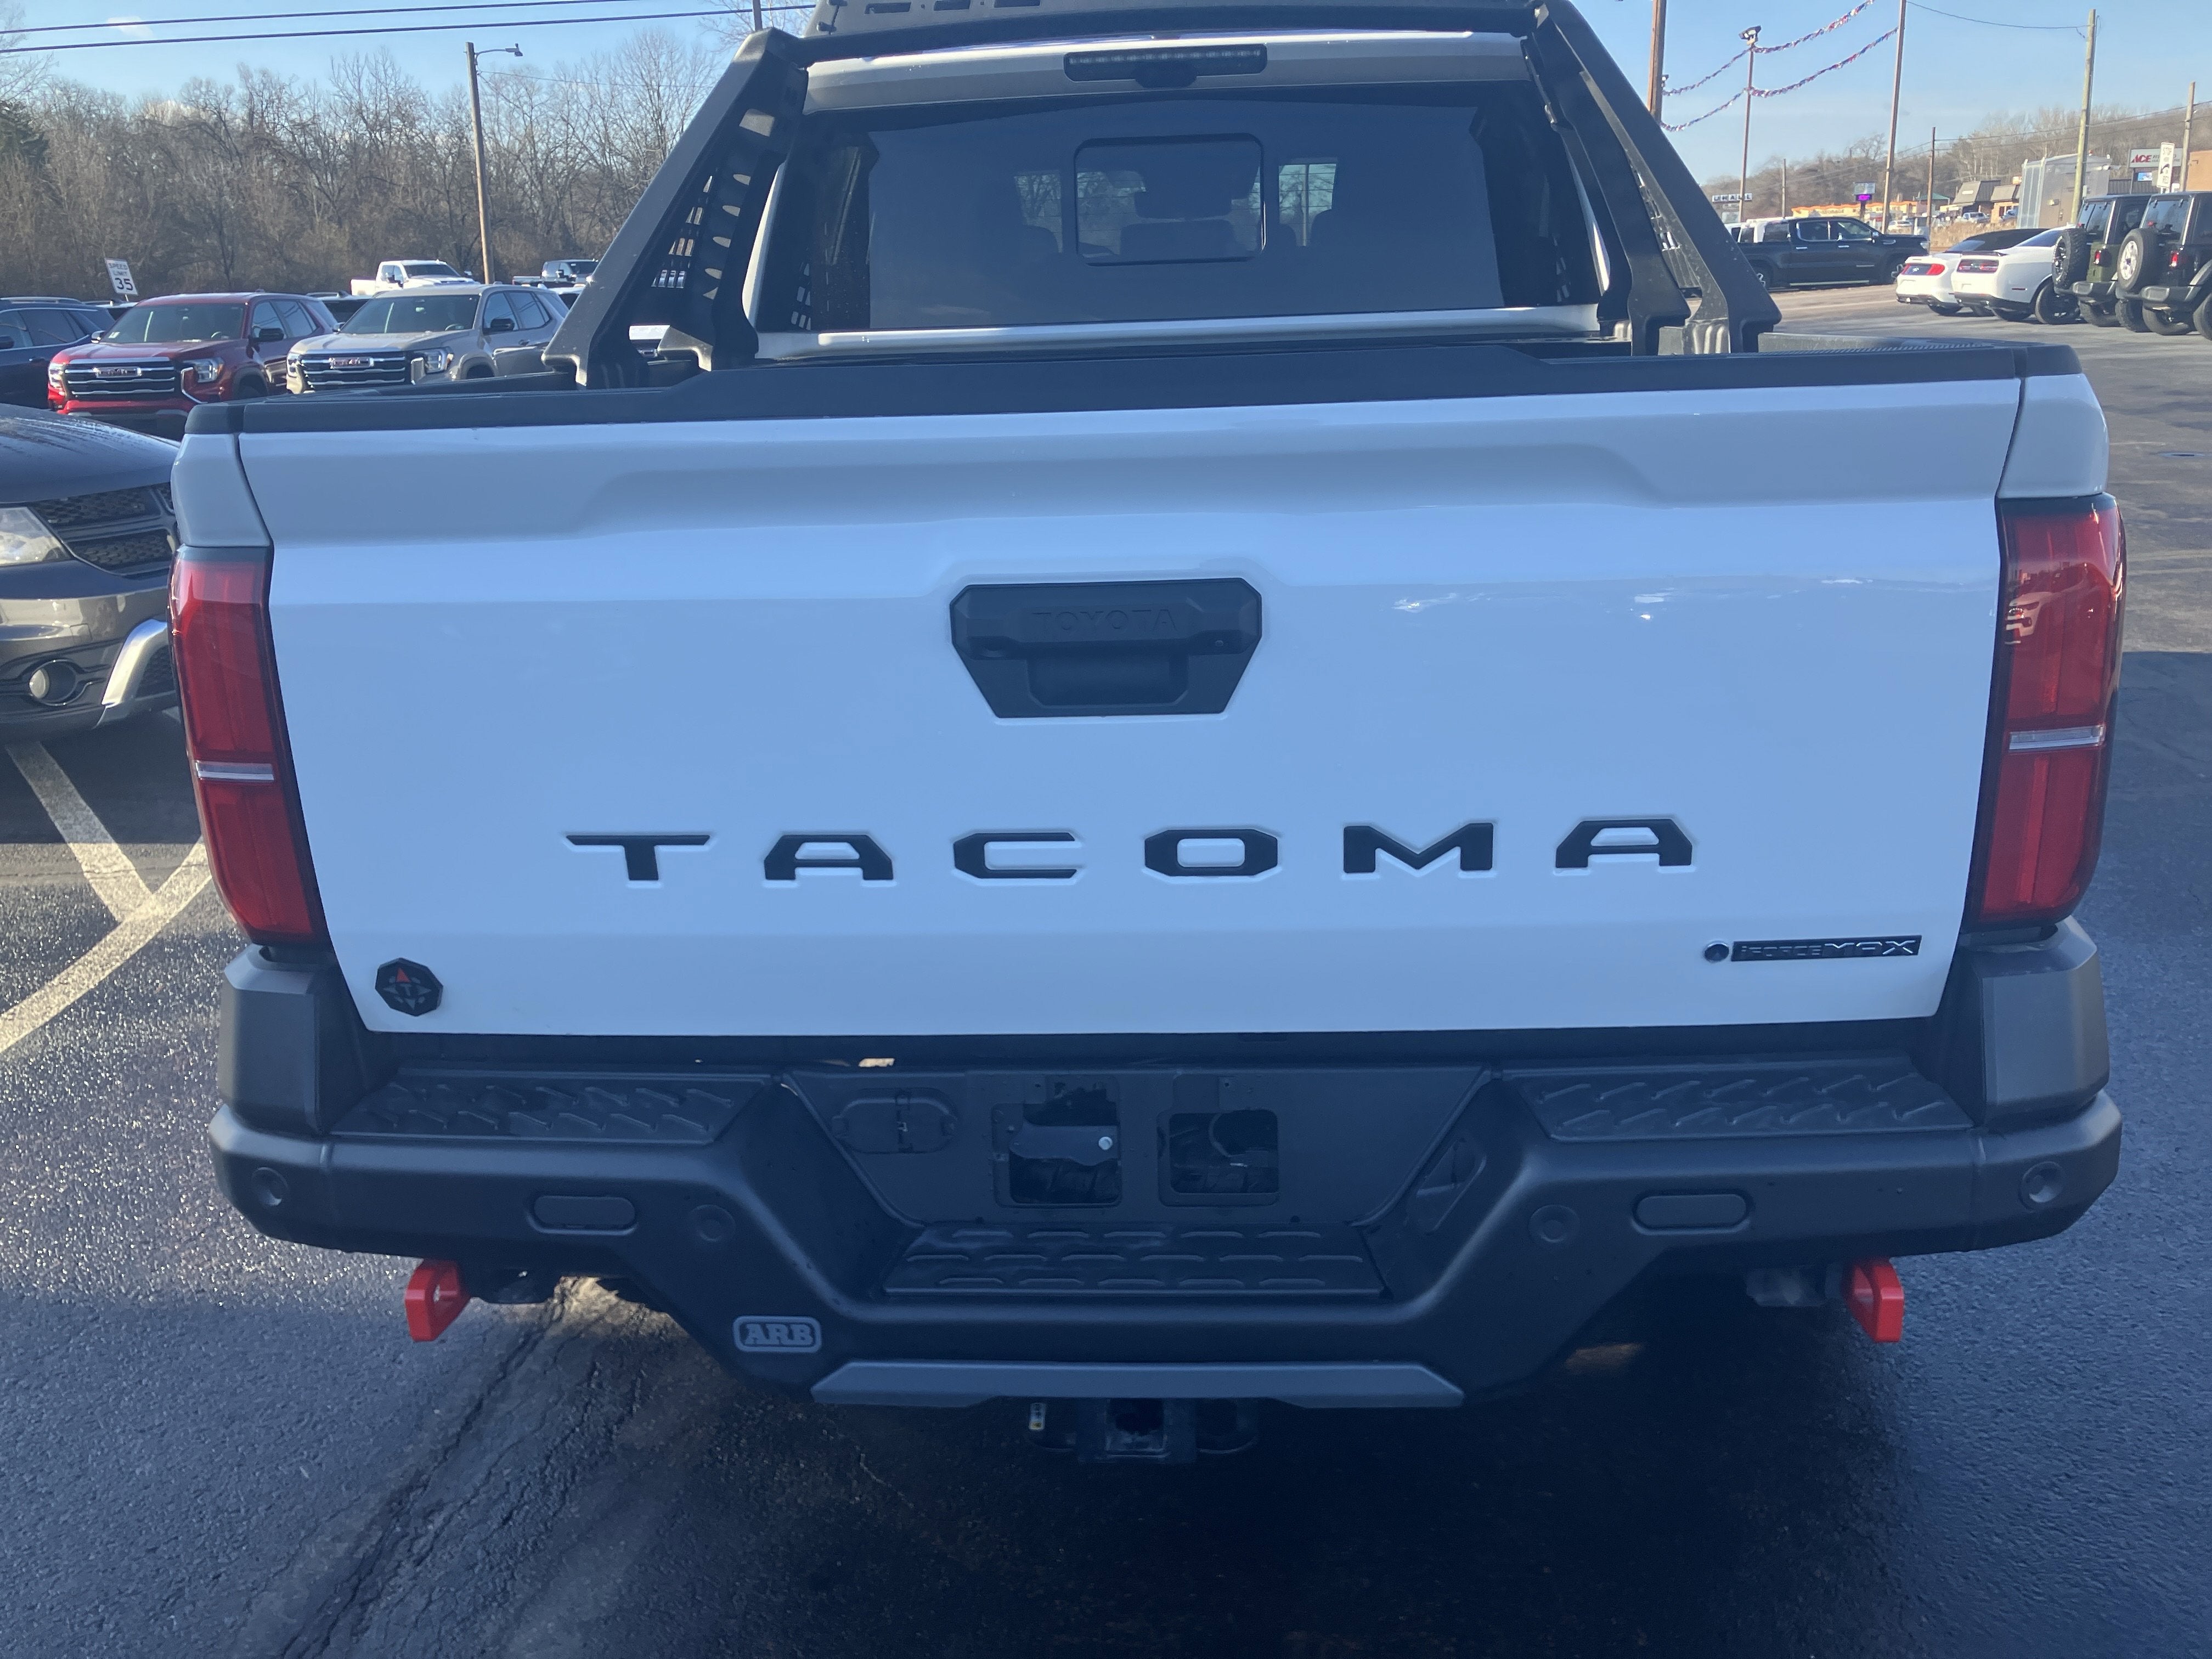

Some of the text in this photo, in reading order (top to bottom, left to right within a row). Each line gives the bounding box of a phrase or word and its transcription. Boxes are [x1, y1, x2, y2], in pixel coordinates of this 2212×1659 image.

[2131, 154, 2152, 163] ACE
[115, 278, 133, 291] 35
[1032, 608, 1178, 631] TOYOTA
[566, 819, 1692, 881] TACOMA
[744, 1323, 814, 1345] ARB
